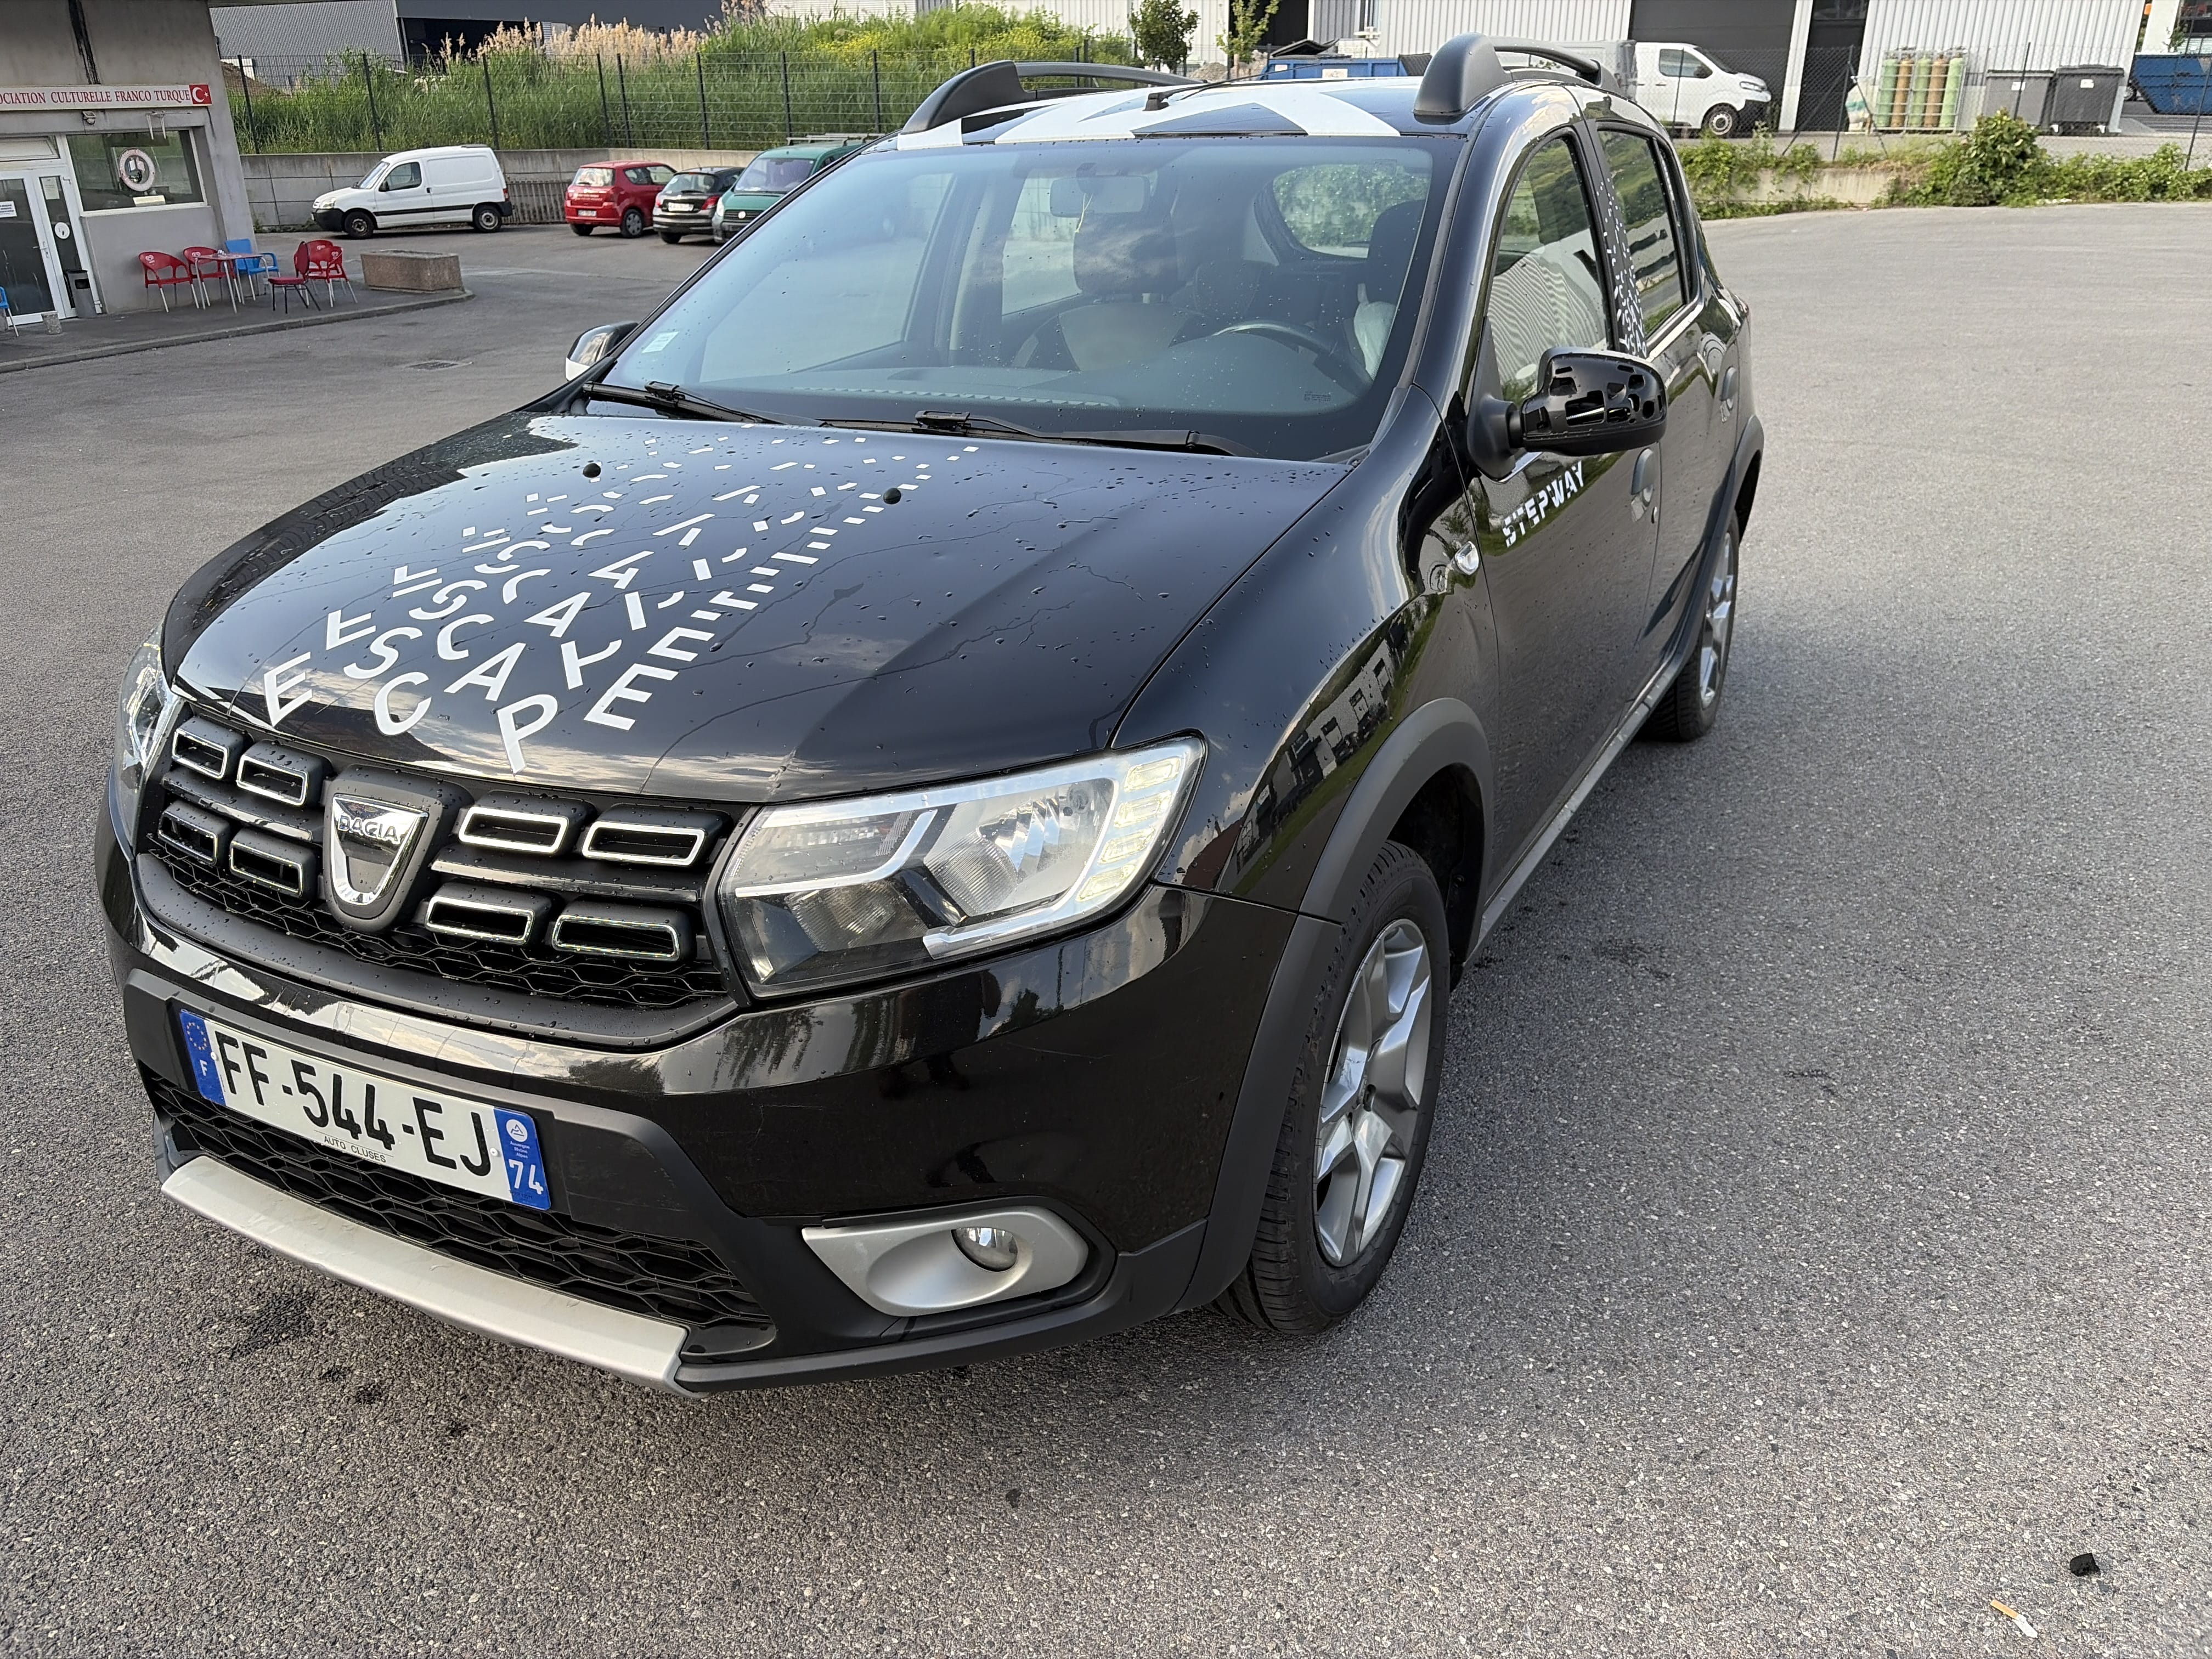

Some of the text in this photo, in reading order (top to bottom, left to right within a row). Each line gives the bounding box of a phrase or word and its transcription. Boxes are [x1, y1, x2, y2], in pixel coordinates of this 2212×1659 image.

[50, 91, 112, 103] CULTURELLE
[114, 91, 151, 101] FRANCO
[154, 89, 190, 103] TURQUE
[1502, 460, 1584, 548] STEPWAY
[263, 626, 679, 775] ESCAPE
[337, 815, 400, 844] DACIA
[199, 1059, 208, 1076] F
[215, 1030, 492, 1177] FF-544-EJ
[324, 1135, 386, 1163] AUTO CLUSES
[510, 1141, 530, 1149] Auvergne
[508, 1159, 544, 1195] 74
